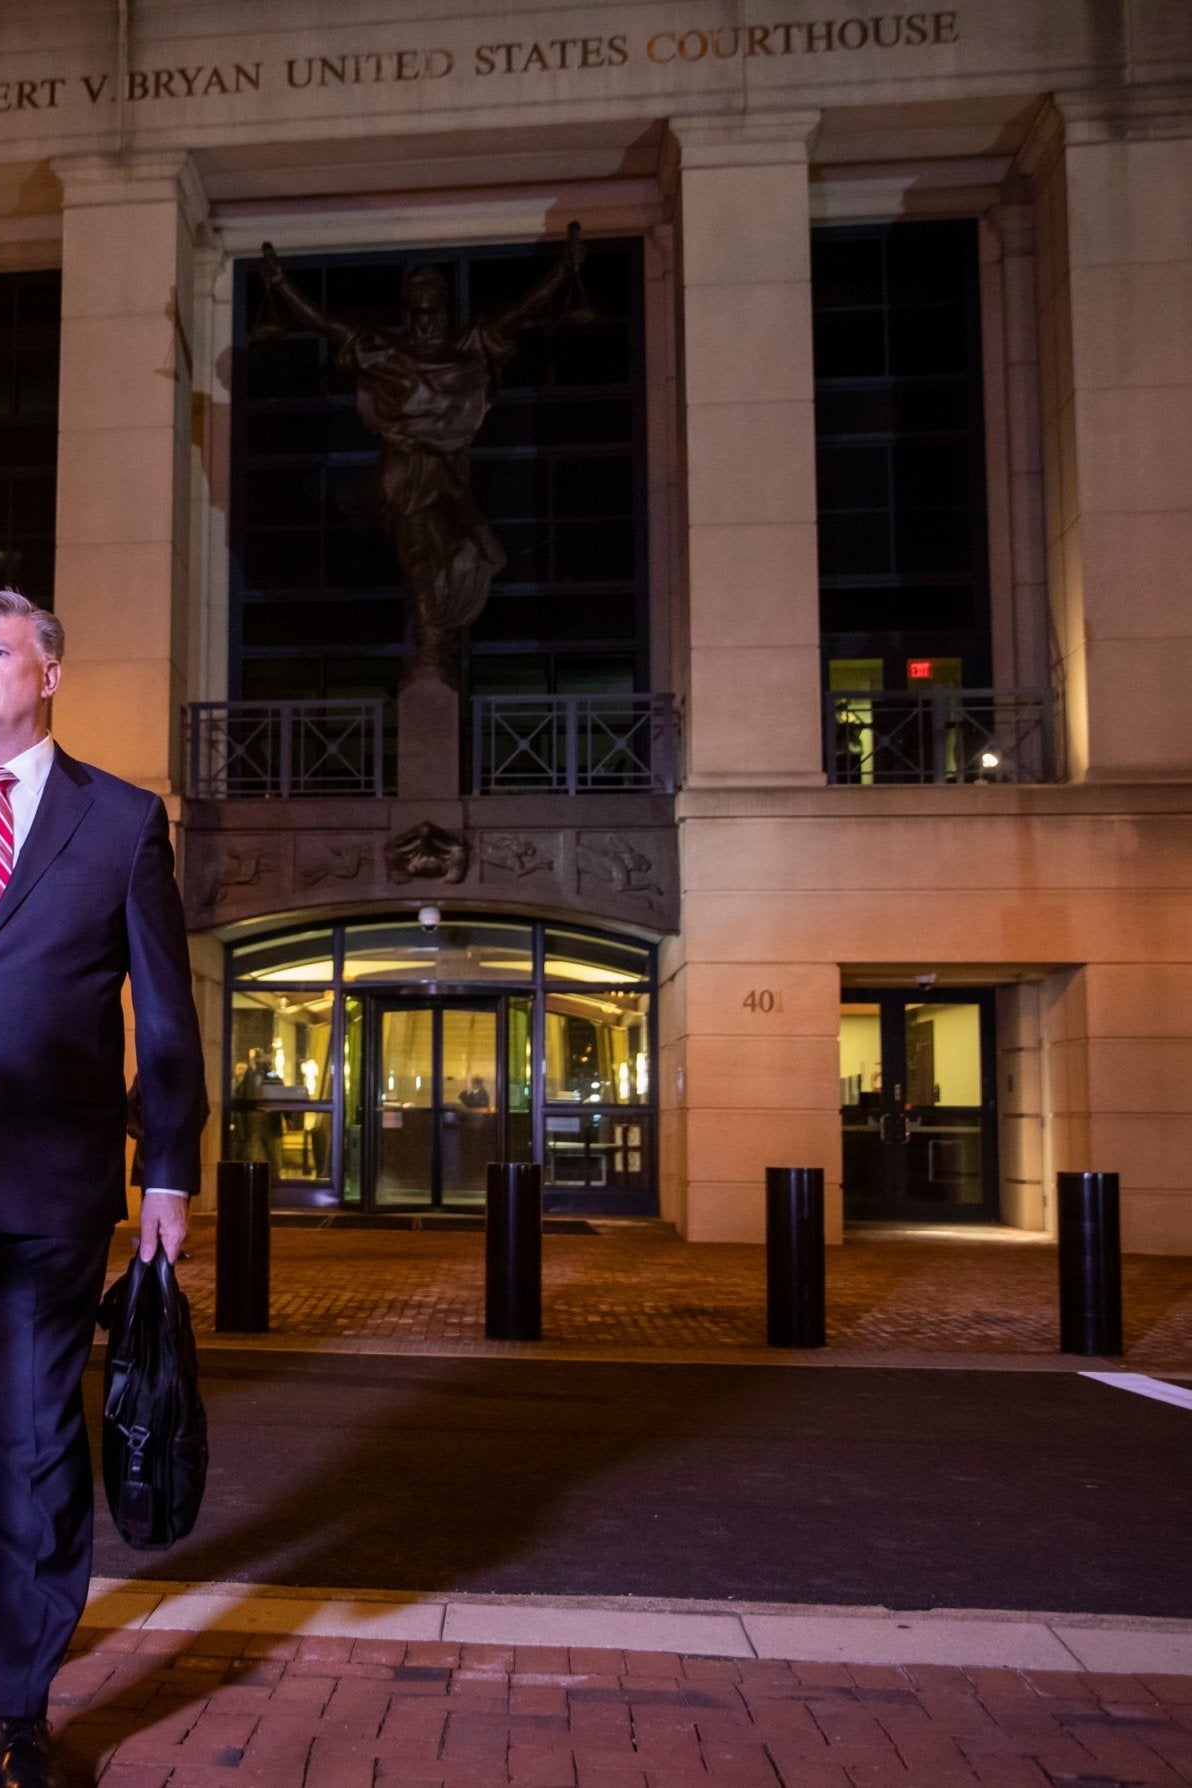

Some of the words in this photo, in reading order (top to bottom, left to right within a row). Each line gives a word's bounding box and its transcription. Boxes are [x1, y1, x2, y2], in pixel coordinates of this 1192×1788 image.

[126, 61, 263, 101] BRYAN
[285, 48, 455, 89] UNITED
[474, 35, 629, 76] STATES
[646, 11, 959, 64] COURTHOUSE
